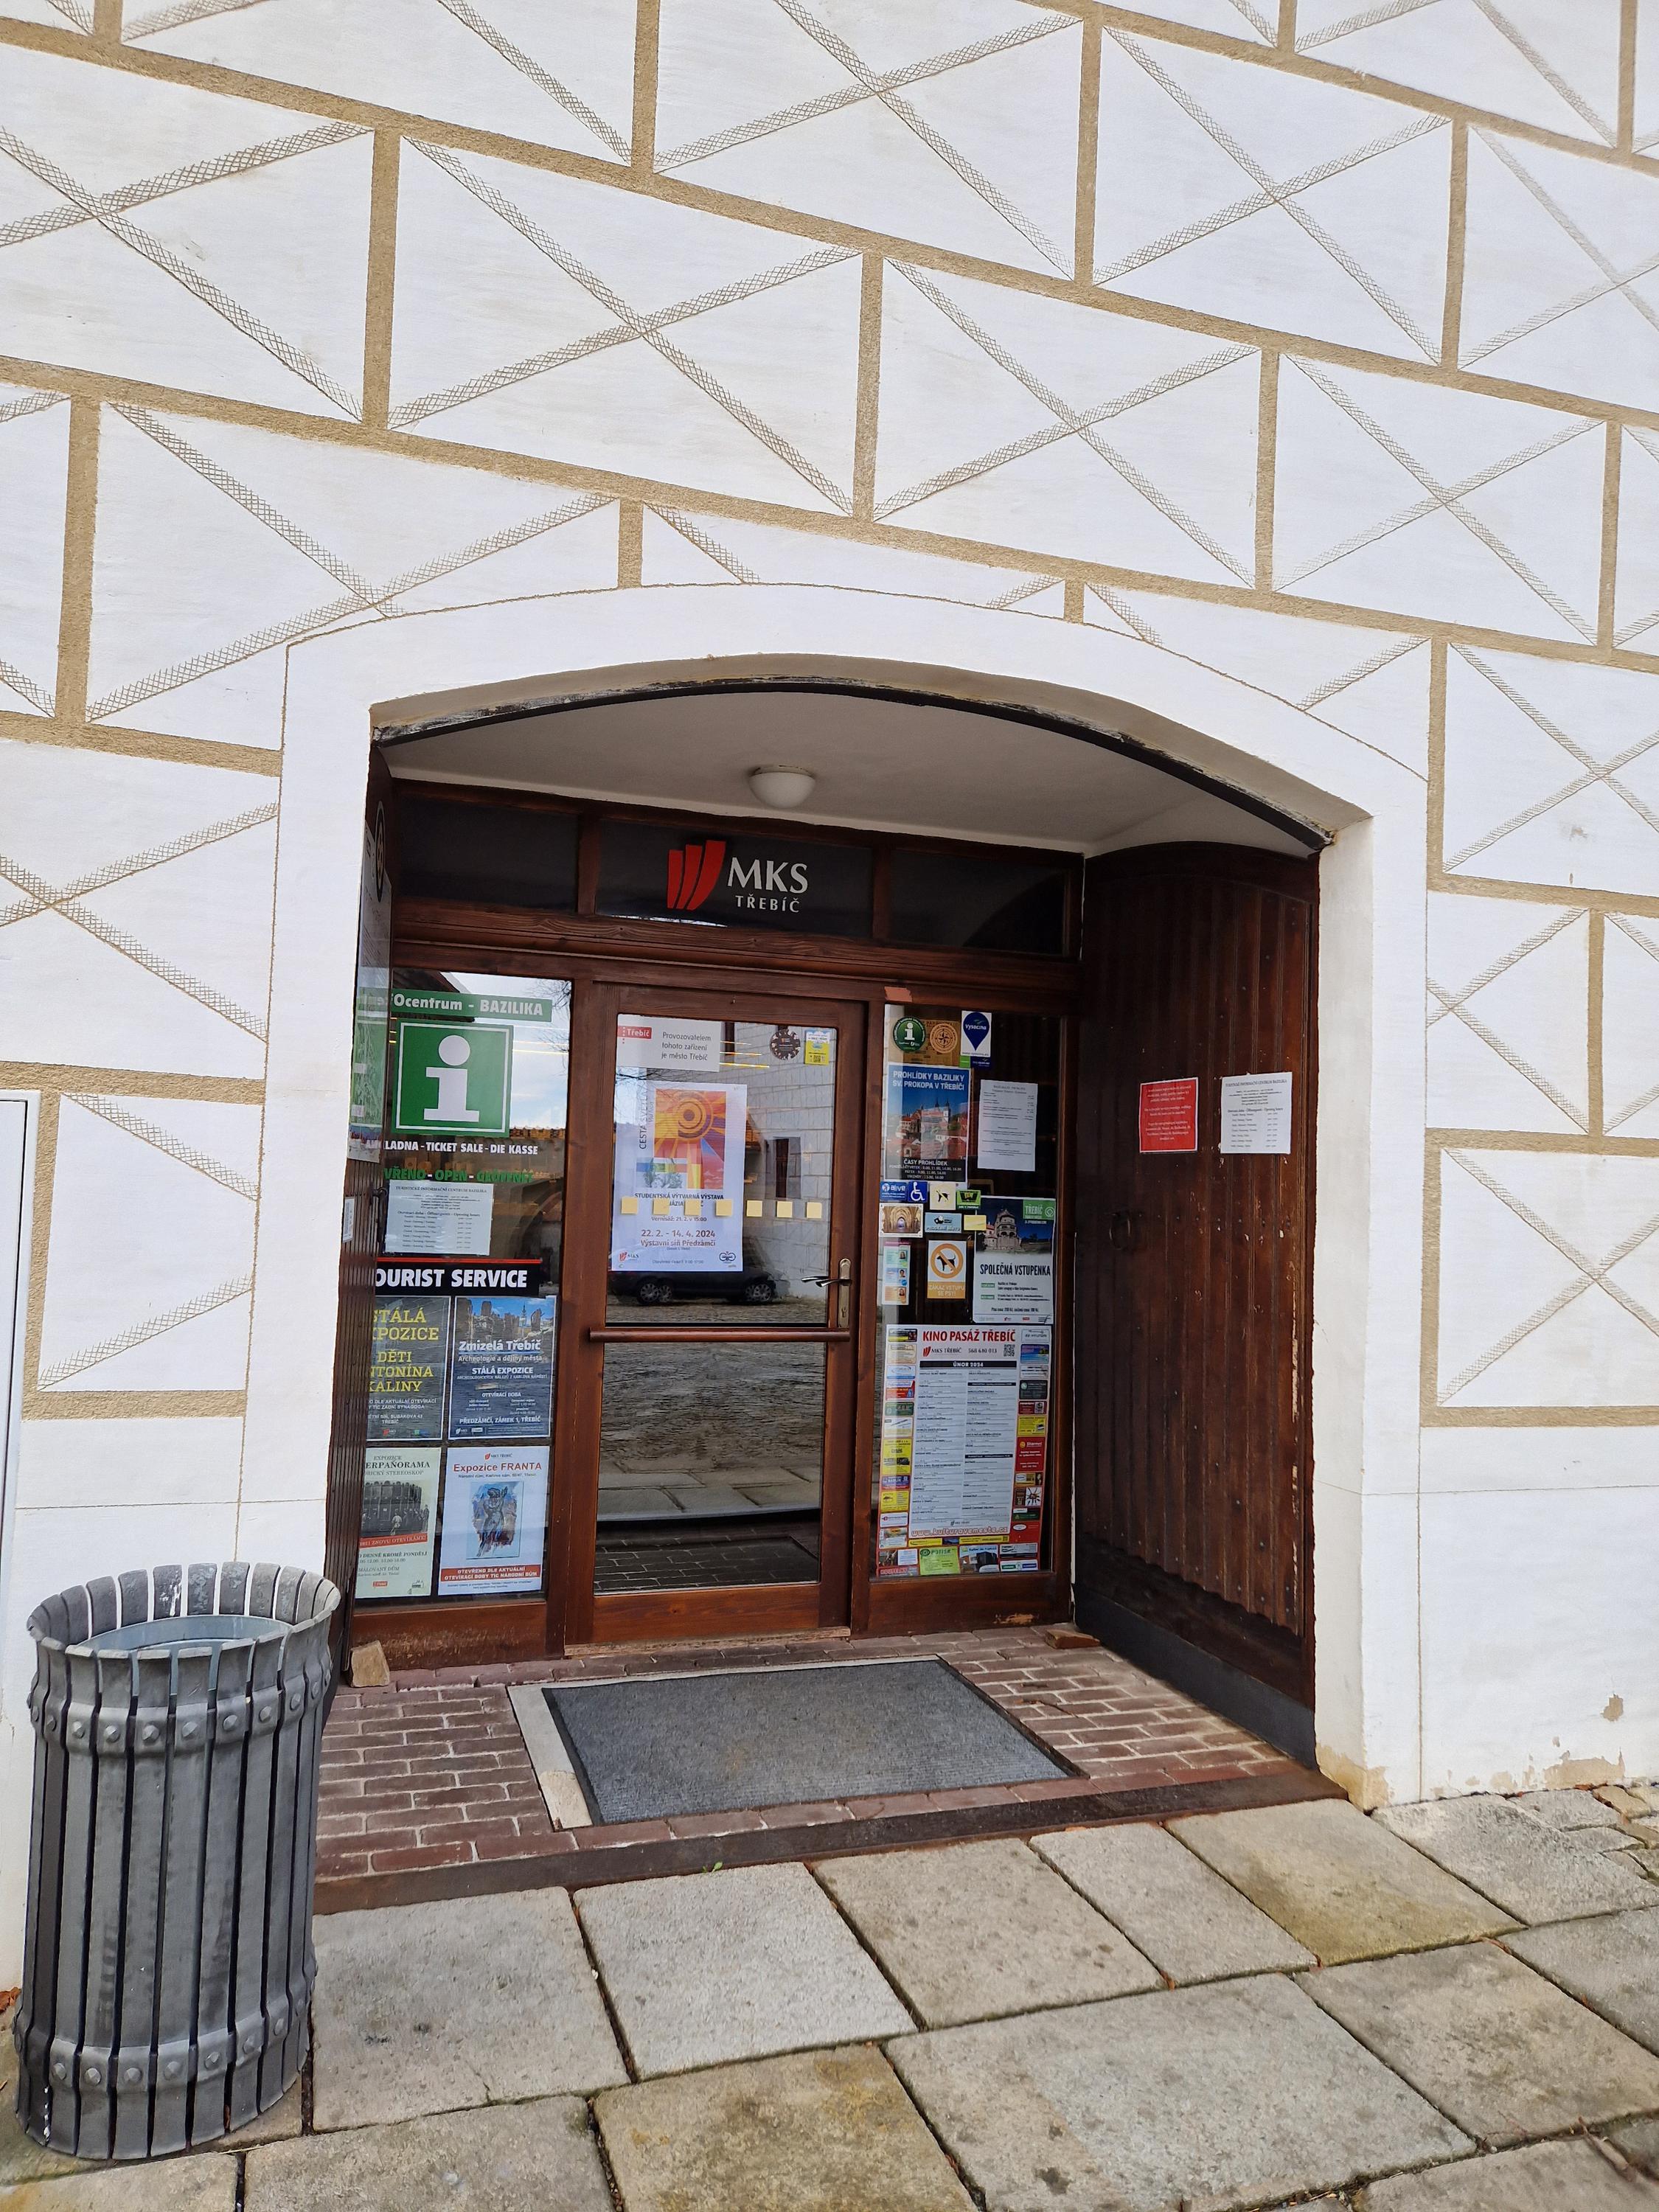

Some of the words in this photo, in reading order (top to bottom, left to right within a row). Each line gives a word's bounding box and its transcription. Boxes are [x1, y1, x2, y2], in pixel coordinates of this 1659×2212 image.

[727, 857, 808, 894] MKS
[735, 894, 800, 913] TŘEBÍČ
[392, 992, 462, 1011] Ocentrum
[480, 999, 543, 1016] BAZILIKA
[627, 1027, 650, 1037] Třebíč
[662, 1032, 712, 1043] Provozovatelem
[661, 1042, 684, 1051] tohoto
[684, 1043, 708, 1051] zařízení
[661, 1052, 667, 1060] je
[668, 1052, 688, 1060] město
[689, 1052, 708, 1061] Třebíč
[893, 1069, 933, 1081] PROHLÍDKY
[933, 1073, 965, 1082] BAZILIKY
[903, 1080, 934, 1089] PROKOPA
[934, 1082, 940, 1090] V
[940, 1081, 965, 1091] TŘEBÍČI
[639, 1125, 647, 1150] CESTA
[384, 1141, 419, 1152] LADNA
[425, 1141, 457, 1153] TICKET
[460, 1143, 484, 1154] SALE
[490, 1144, 505, 1155] DIE
[508, 1145, 538, 1155] KASSE
[434, 1169, 468, 1181] OPEN
[1026, 1204, 1043, 1215] TŘEBÍČ
[641, 1229, 654, 1237] 22.
[655, 1229, 664, 1237] 2.
[686, 1230, 694, 1238] 4.
[695, 1230, 715, 1238] 2024
[641, 1239, 669, 1247] Výstavní
[980, 1262, 1013, 1276] SPOLEČNÁ
[1015, 1265, 1051, 1276] VSTUPENKA
[451, 1269, 528, 1288] SERVICE
[923, 1331, 947, 1342] KINO
[949, 1329, 980, 1342] PASÁŽ
[982, 1329, 1016, 1342] TŘEBÍČ
[459, 1338, 504, 1351] Zmizelá
[506, 1338, 541, 1351] Třebíč
[377, 1349, 412, 1363] DĚTI
[458, 1355, 495, 1363] Archeologie
[502, 1355, 522, 1363] dějiny
[472, 1366, 495, 1374] STÁLÁ
[459, 1416, 494, 1425] PŘEDZÁMČÍ,
[495, 1416, 515, 1424] ZÁMEK
[521, 1415, 541, 1423] TŘEBÍČ
[453, 1464, 498, 1473] Expozice
[501, 1462, 542, 1471] FRANTA
[911, 1525, 1009, 1537] www.kulturavemeste.cz
